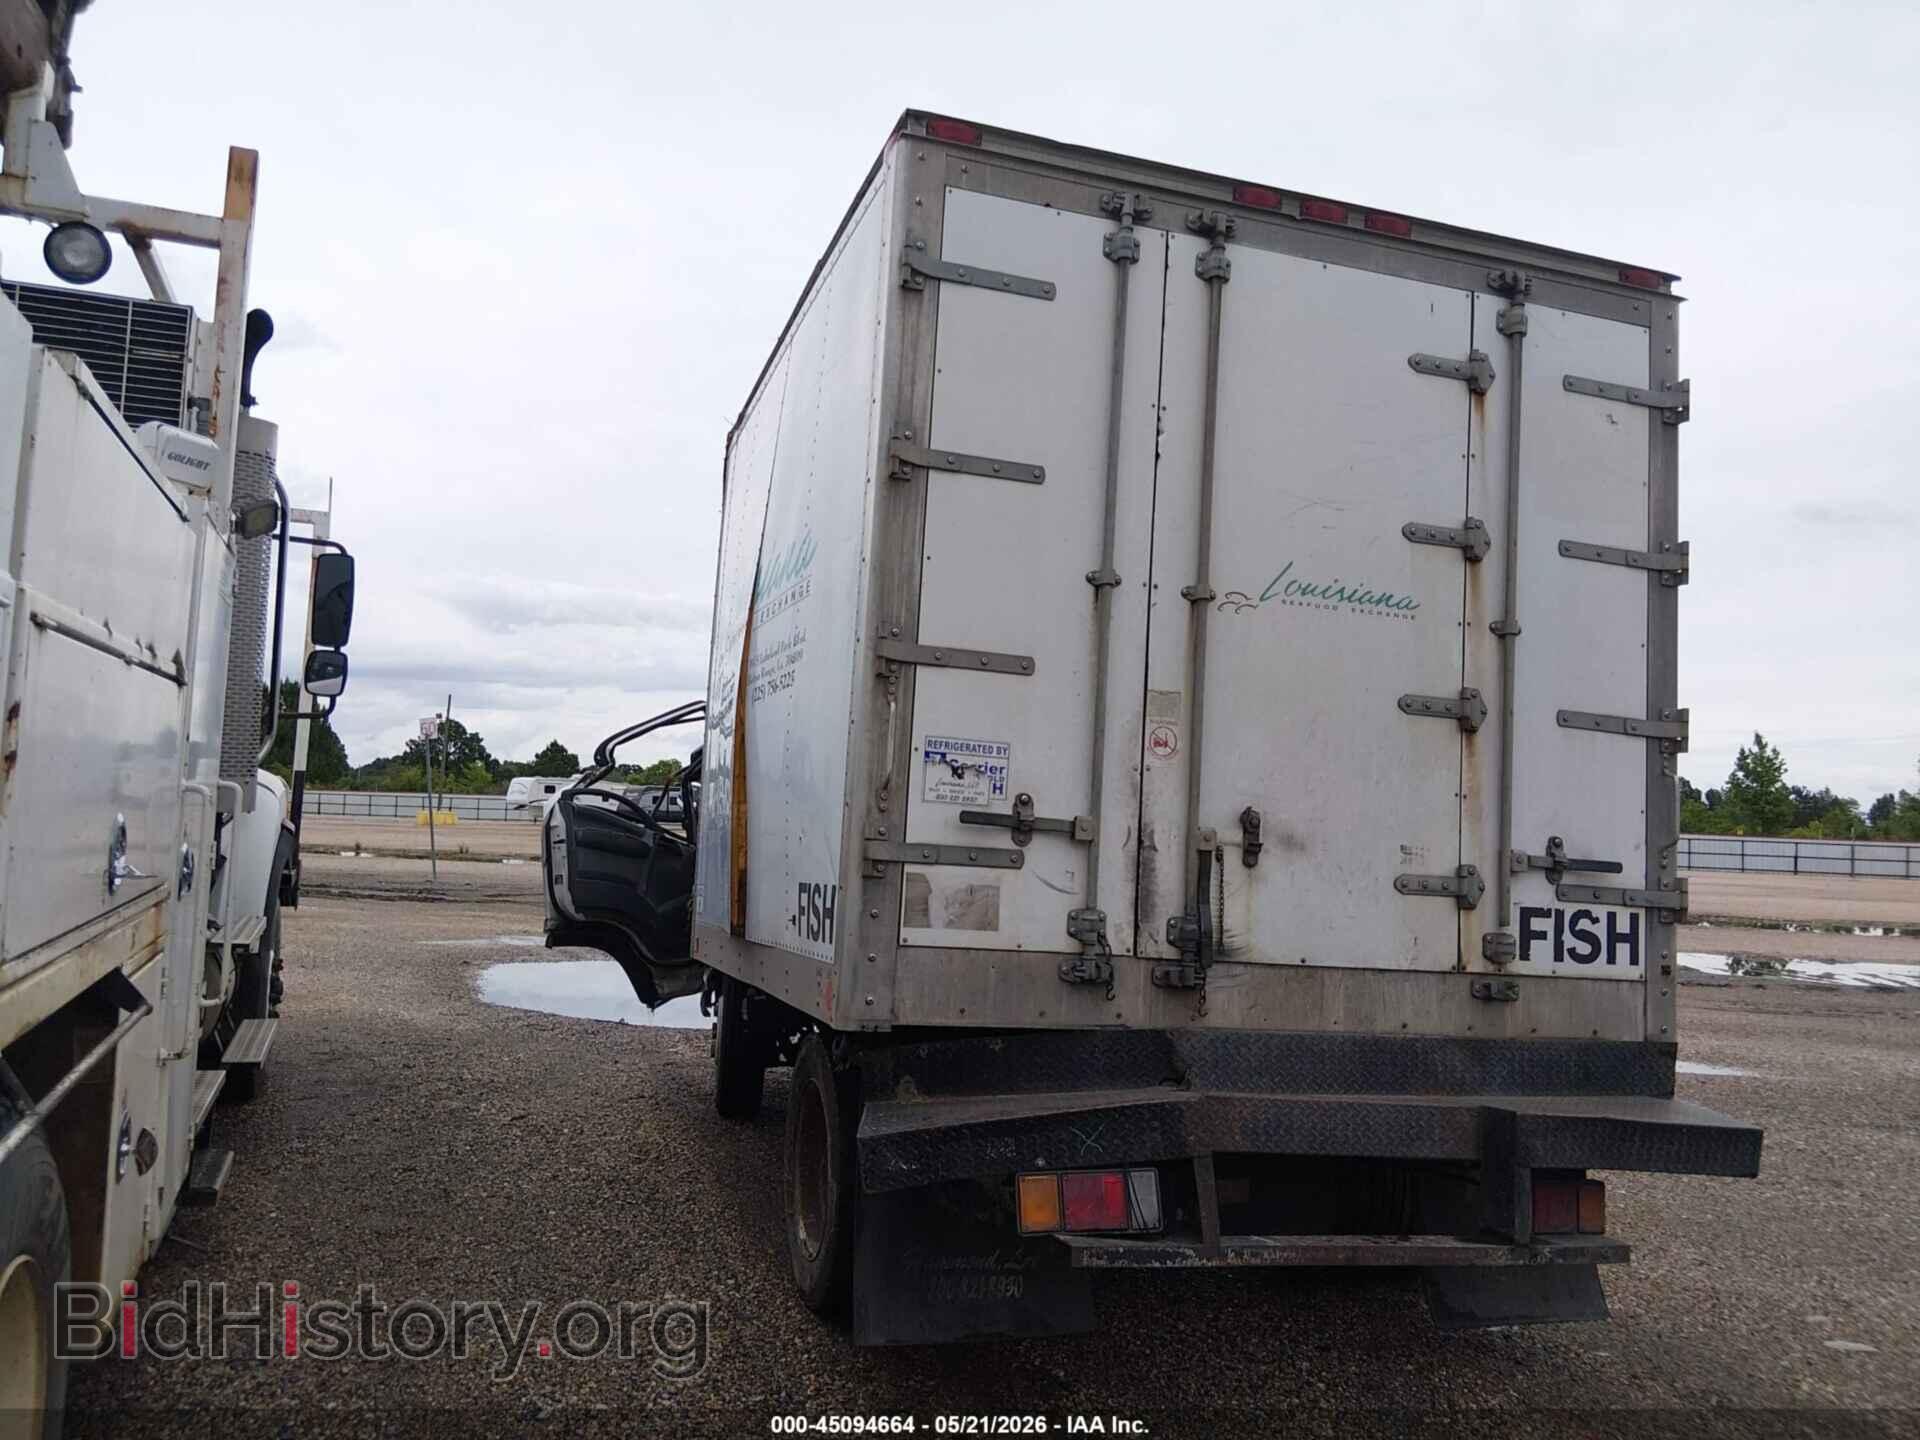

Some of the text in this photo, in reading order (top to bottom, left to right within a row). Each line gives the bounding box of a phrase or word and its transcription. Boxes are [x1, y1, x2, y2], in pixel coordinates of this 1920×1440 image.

[168, 451, 211, 471] GOLIGHT
[759, 580, 813, 624] EXCHANGE
[1259, 560, 1421, 611] Louisiana
[1352, 608, 1416, 621] EXCHANGE
[927, 739, 1008, 756] REFRIGERATED BY
[797, 882, 837, 944] FISH
[1518, 906, 1640, 966] FISH
